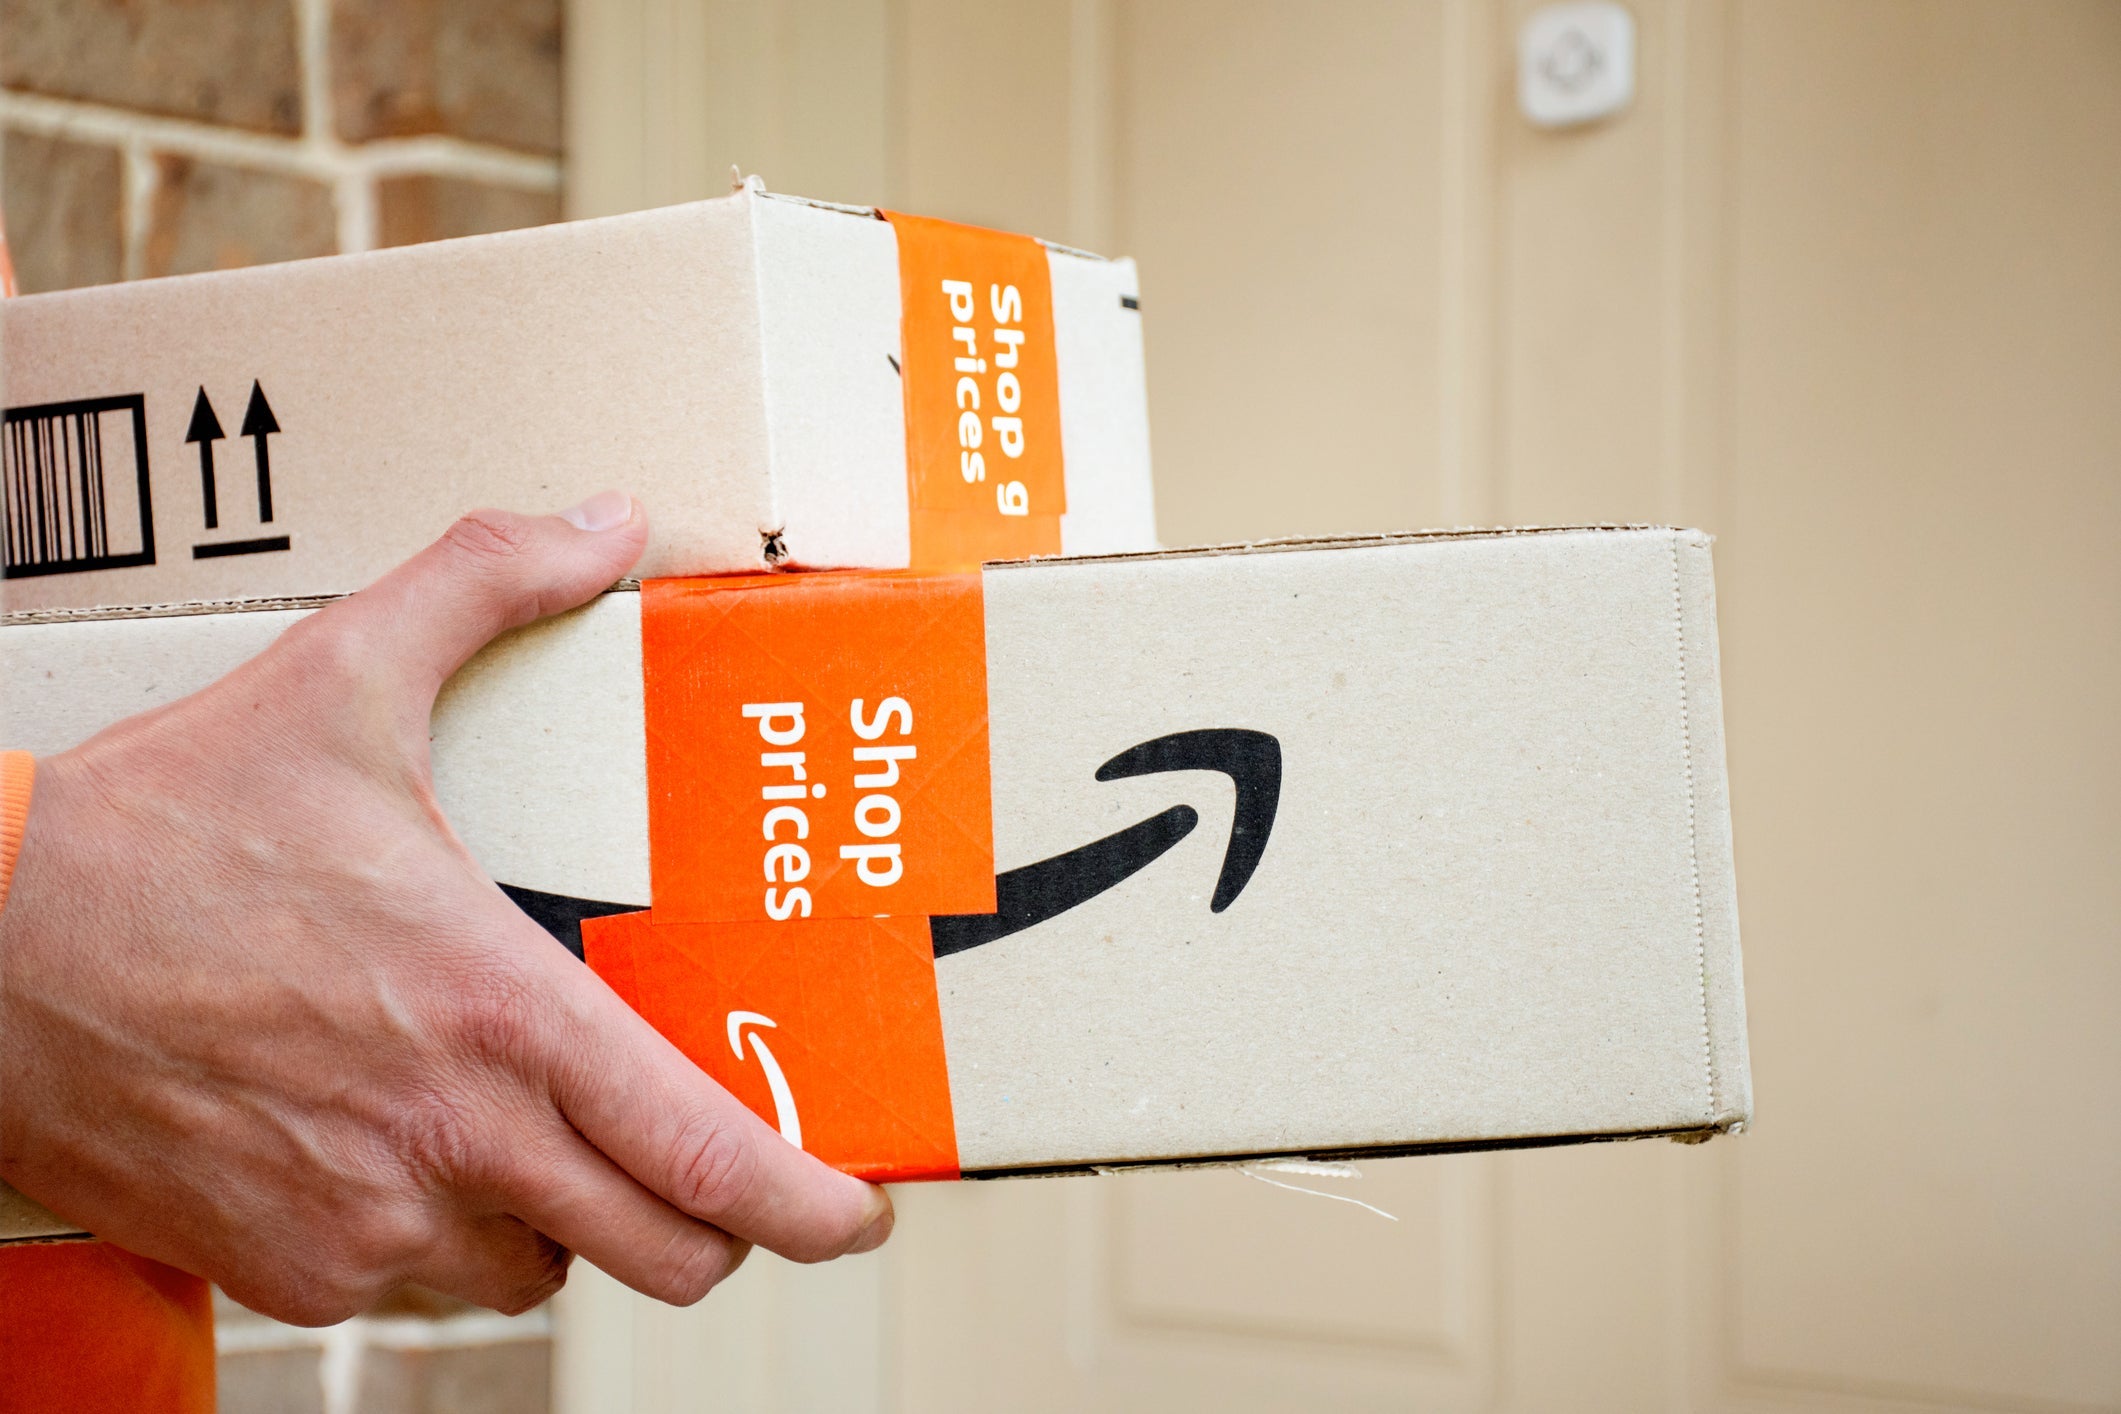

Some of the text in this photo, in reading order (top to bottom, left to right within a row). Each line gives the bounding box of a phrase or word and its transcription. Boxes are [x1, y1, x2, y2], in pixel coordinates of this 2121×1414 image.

[941, 279, 987, 484] prices
[990, 283, 1025, 459] Shop
[741, 701, 827, 921] prices
[839, 696, 917, 887] Shop
